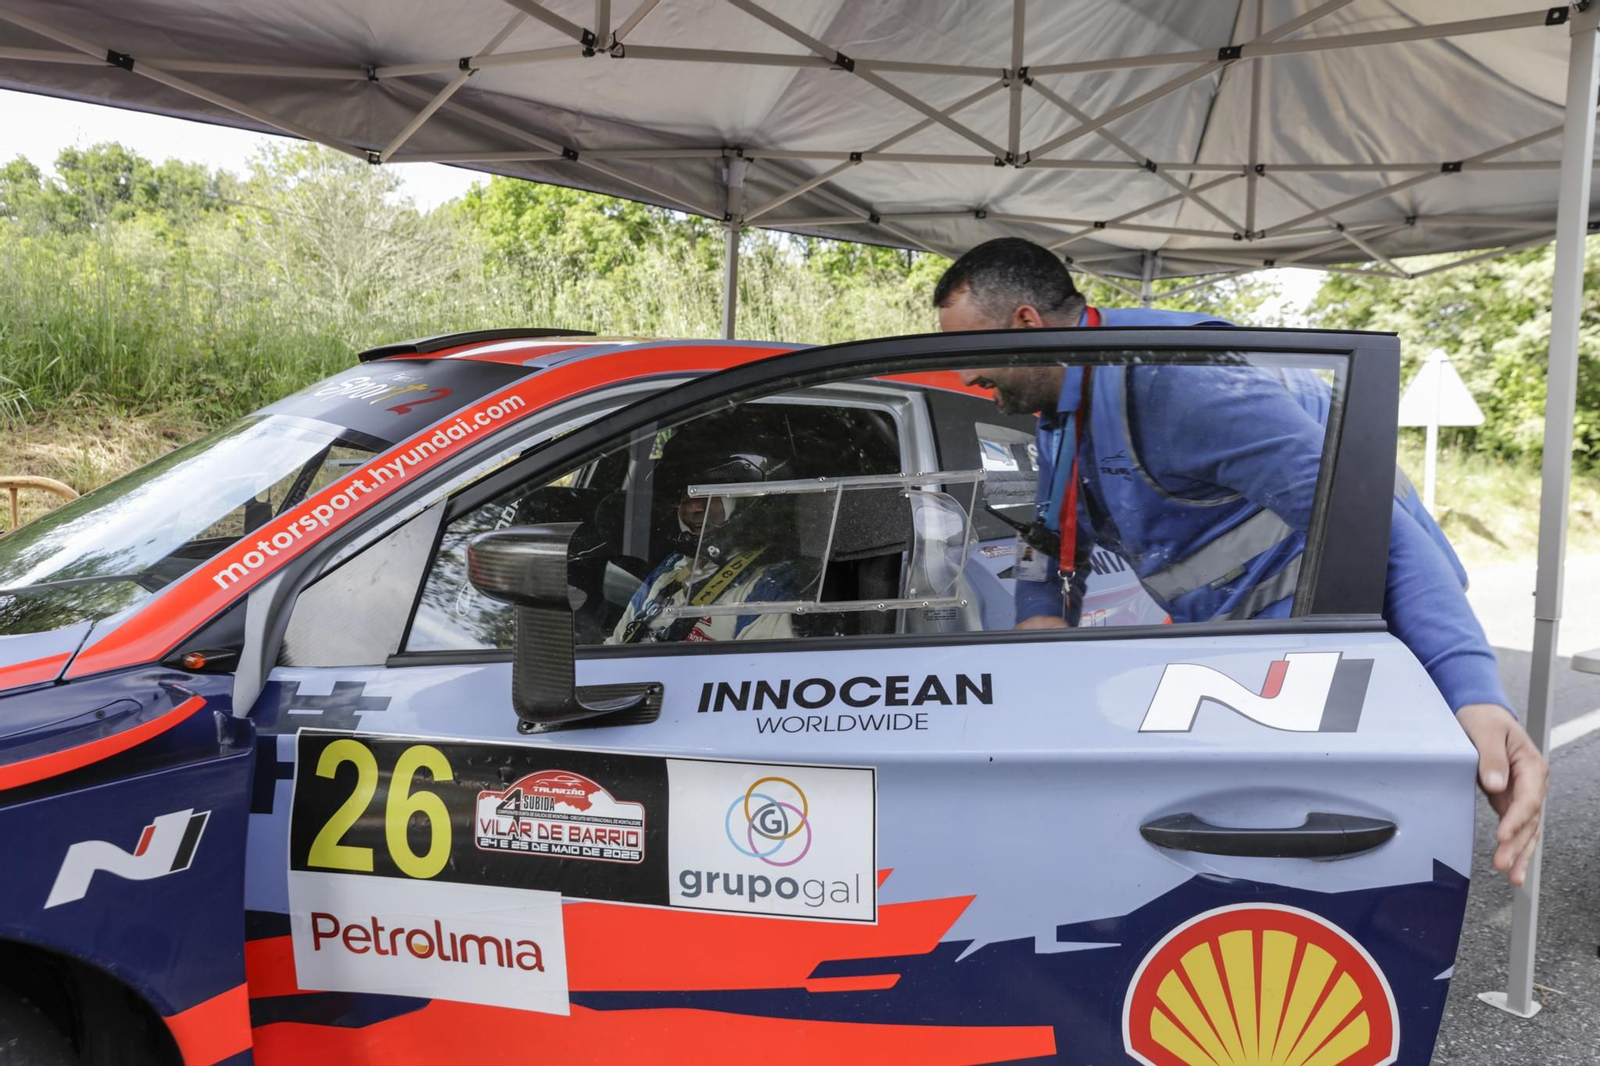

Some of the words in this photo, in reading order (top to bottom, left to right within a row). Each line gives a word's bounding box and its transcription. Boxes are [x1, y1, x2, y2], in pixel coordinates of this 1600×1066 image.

[212, 393, 526, 590] motorsport.hyundai.com
[697, 673, 994, 713] INNOCEAN
[755, 712, 929, 734] WORLDWIDE
[307, 738, 454, 880] 26
[523, 795, 556, 812] SUBIDA
[760, 809, 782, 833] G
[480, 818, 532, 839] VILAR
[537, 824, 563, 842] DE
[568, 825, 639, 849] BARRIO
[480, 837, 498, 848] 24
[500, 839, 509, 849] E
[511, 840, 529, 850] 25
[531, 842, 549, 852] DE
[551, 843, 580, 855] MAIO
[582, 846, 600, 857] DE
[603, 848, 640, 861] 2025
[678, 868, 860, 907] grupogal
[311, 911, 545, 972] Petrolimia
